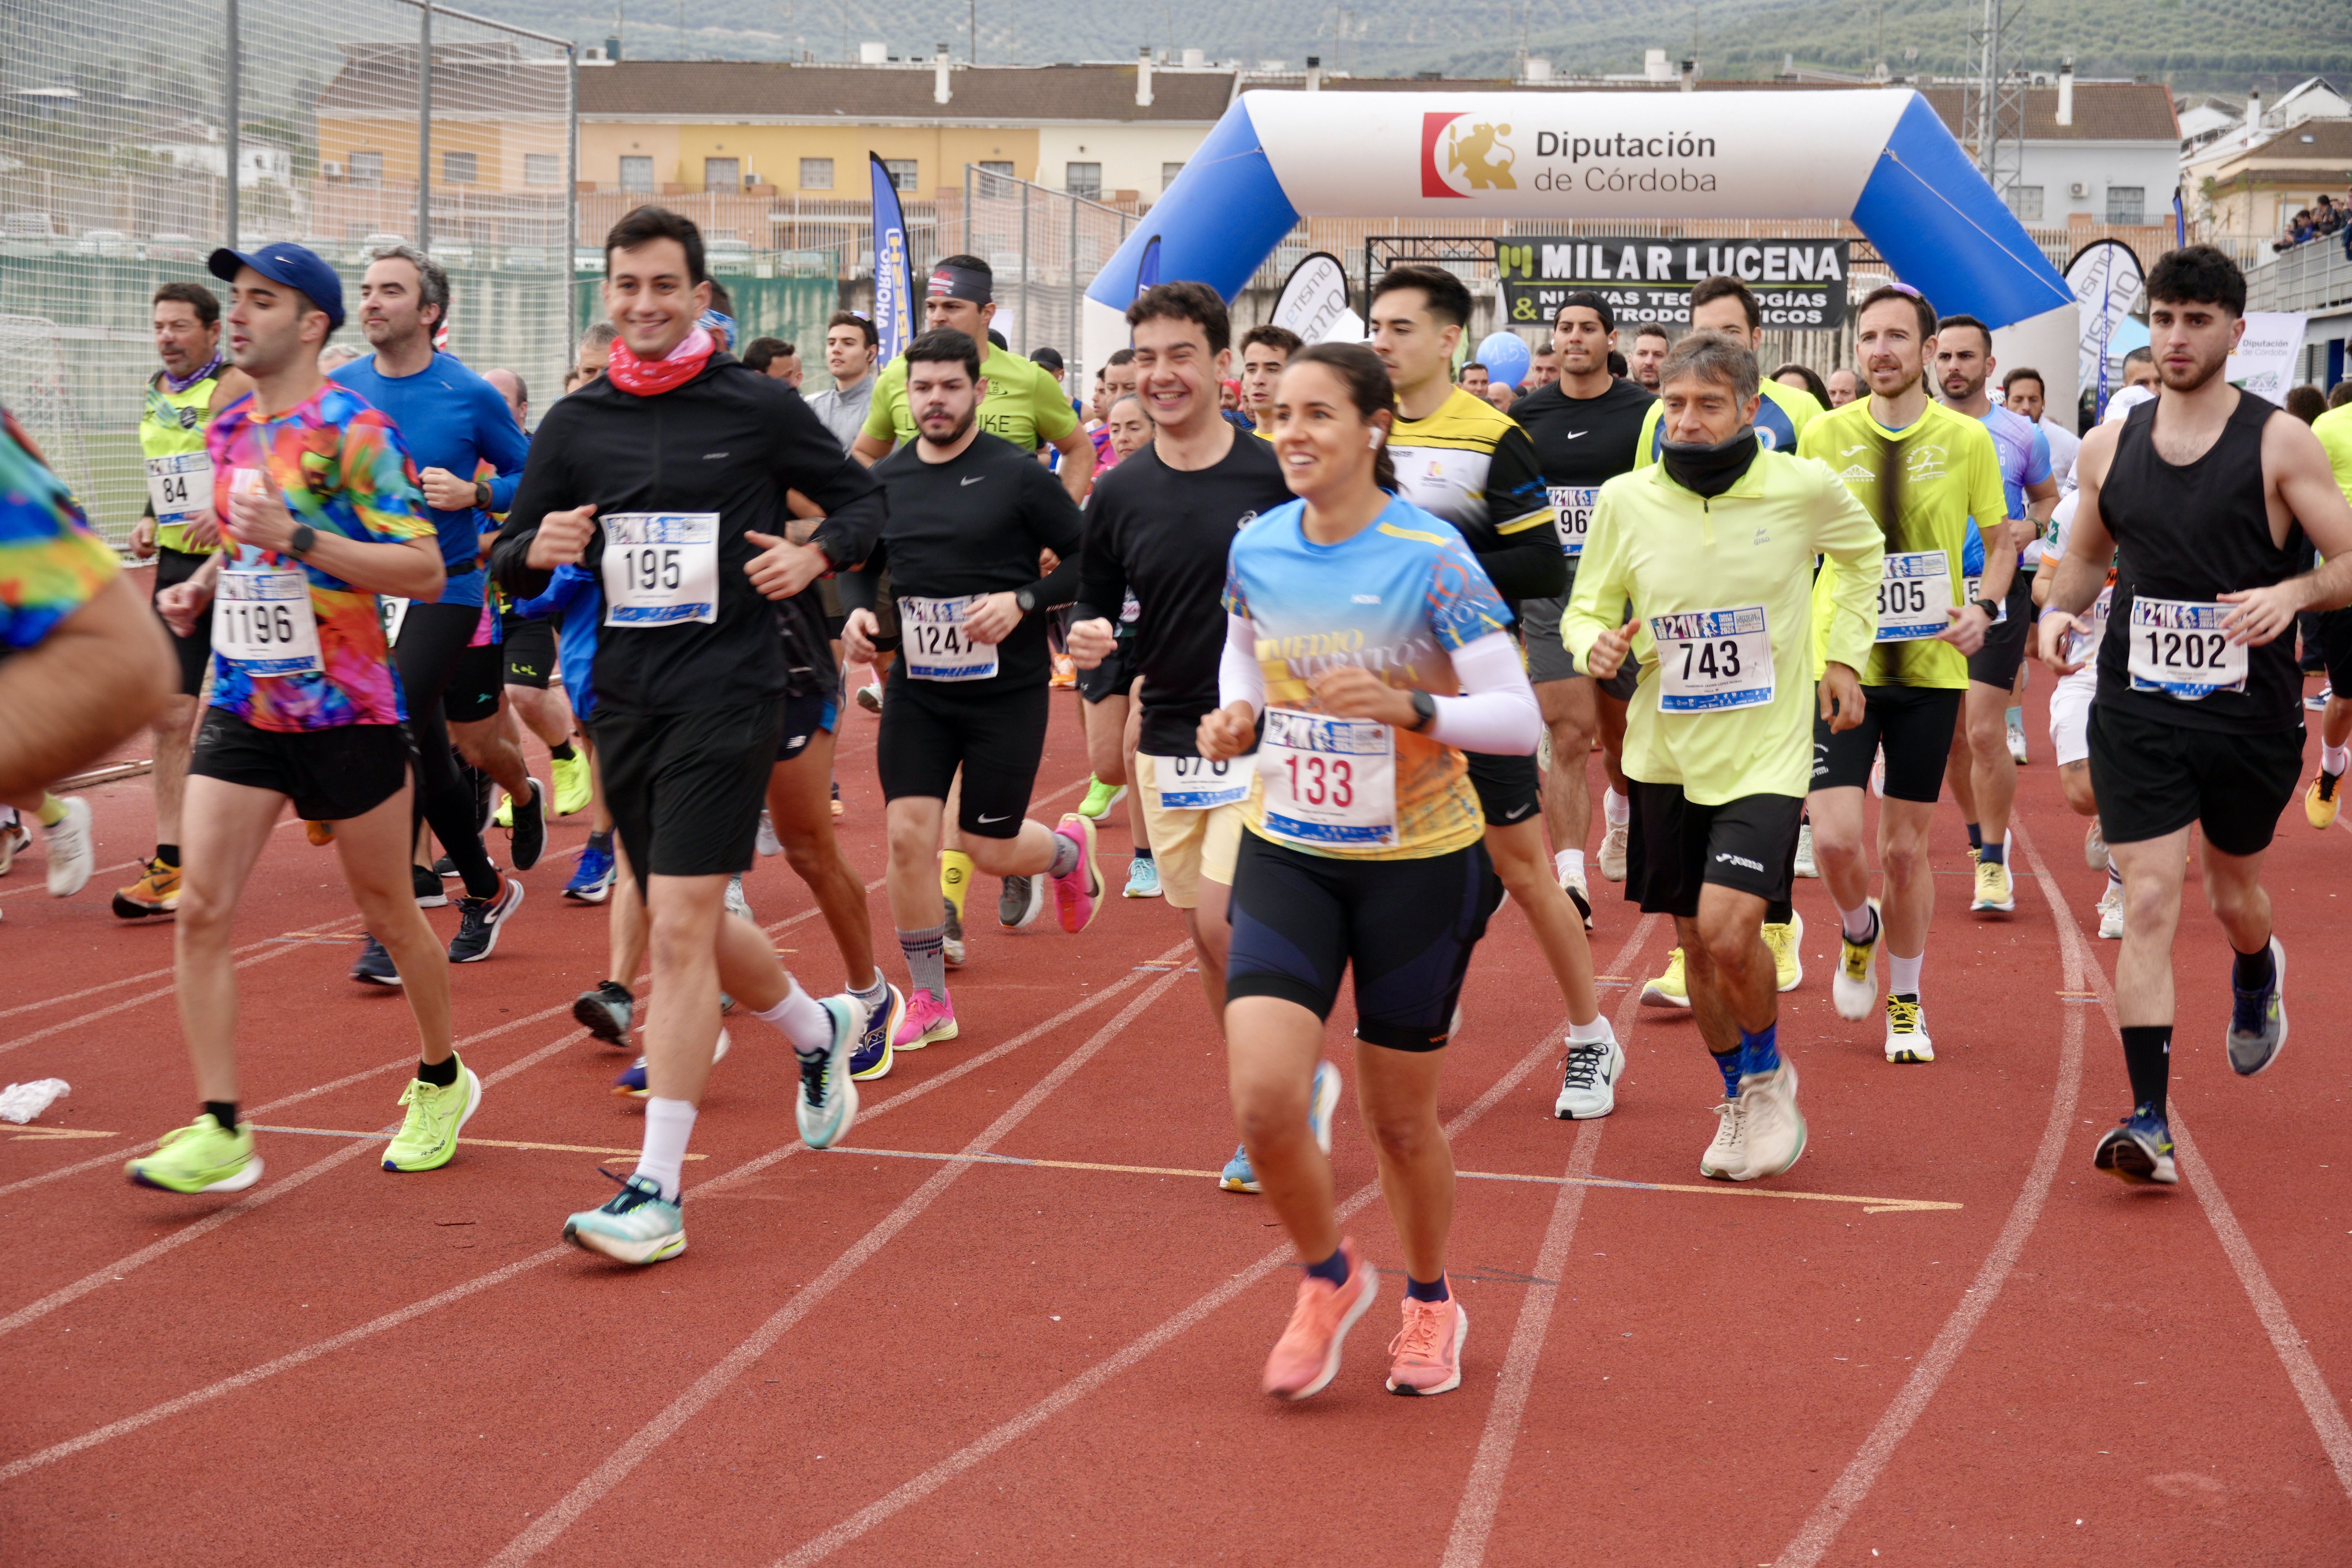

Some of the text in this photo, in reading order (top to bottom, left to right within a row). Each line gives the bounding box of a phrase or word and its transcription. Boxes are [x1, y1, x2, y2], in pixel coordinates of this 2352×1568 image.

[1537, 131, 1715, 163] Diputación
[1535, 167, 1716, 191] de Córdoba
[1541, 244, 1842, 281] MILAR LUCENA
[1513, 297, 1822, 324] & ETRODOICOS
[1540, 290, 1827, 308] NUAS TECOGÍAS
[163, 476, 188, 503] 84
[1561, 509, 1593, 534] 96
[1754, 536, 1770, 546] ipso
[623, 549, 681, 590] 195
[222, 605, 292, 644] 1196
[1665, 614, 1701, 639] 21K
[1679, 640, 1740, 680] 743
[2145, 631, 2226, 669] 1202
[1286, 754, 1353, 808] 133
